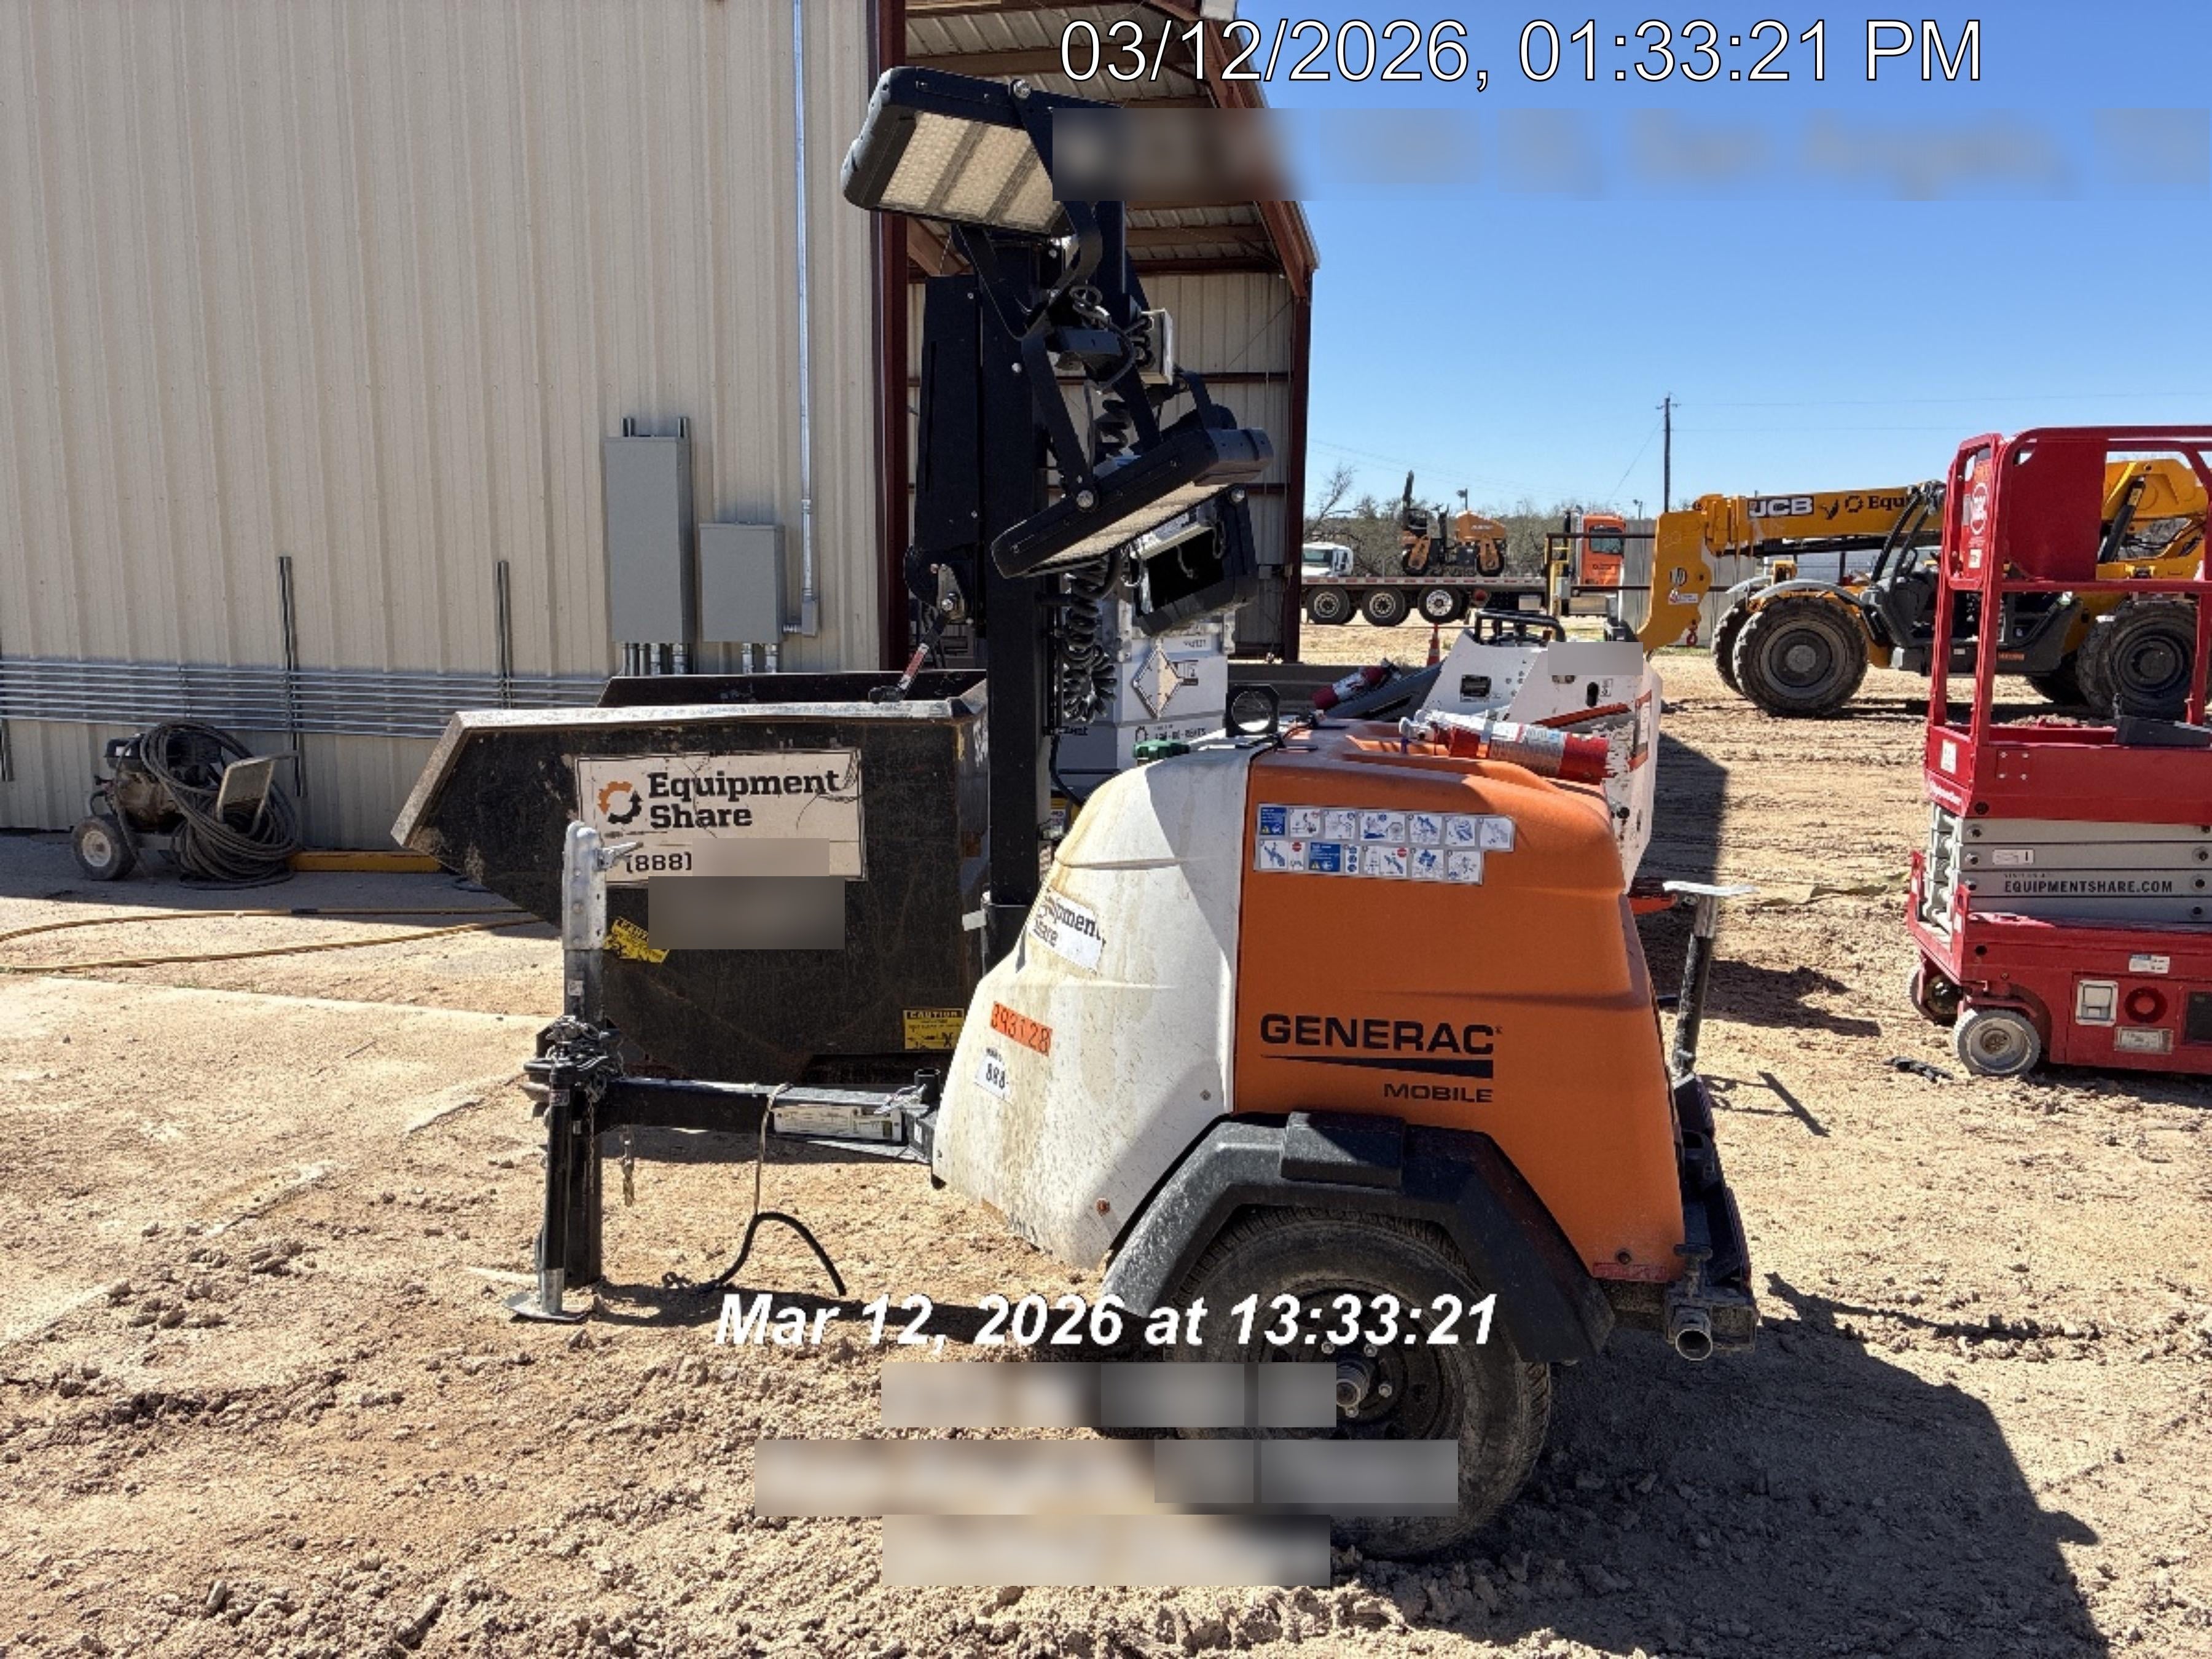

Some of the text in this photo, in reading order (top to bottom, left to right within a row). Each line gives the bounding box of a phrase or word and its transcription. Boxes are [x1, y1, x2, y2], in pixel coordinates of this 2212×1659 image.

[1749, 497, 1813, 517] JCB
[648, 770, 839, 802] Equipment
[650, 804, 753, 828] Share
[2004, 880, 2173, 893] EQUIPMENTSHARE.COM
[1260, 1013, 1494, 1056] GENERAC
[1384, 1083, 1494, 1103] MOBILE
